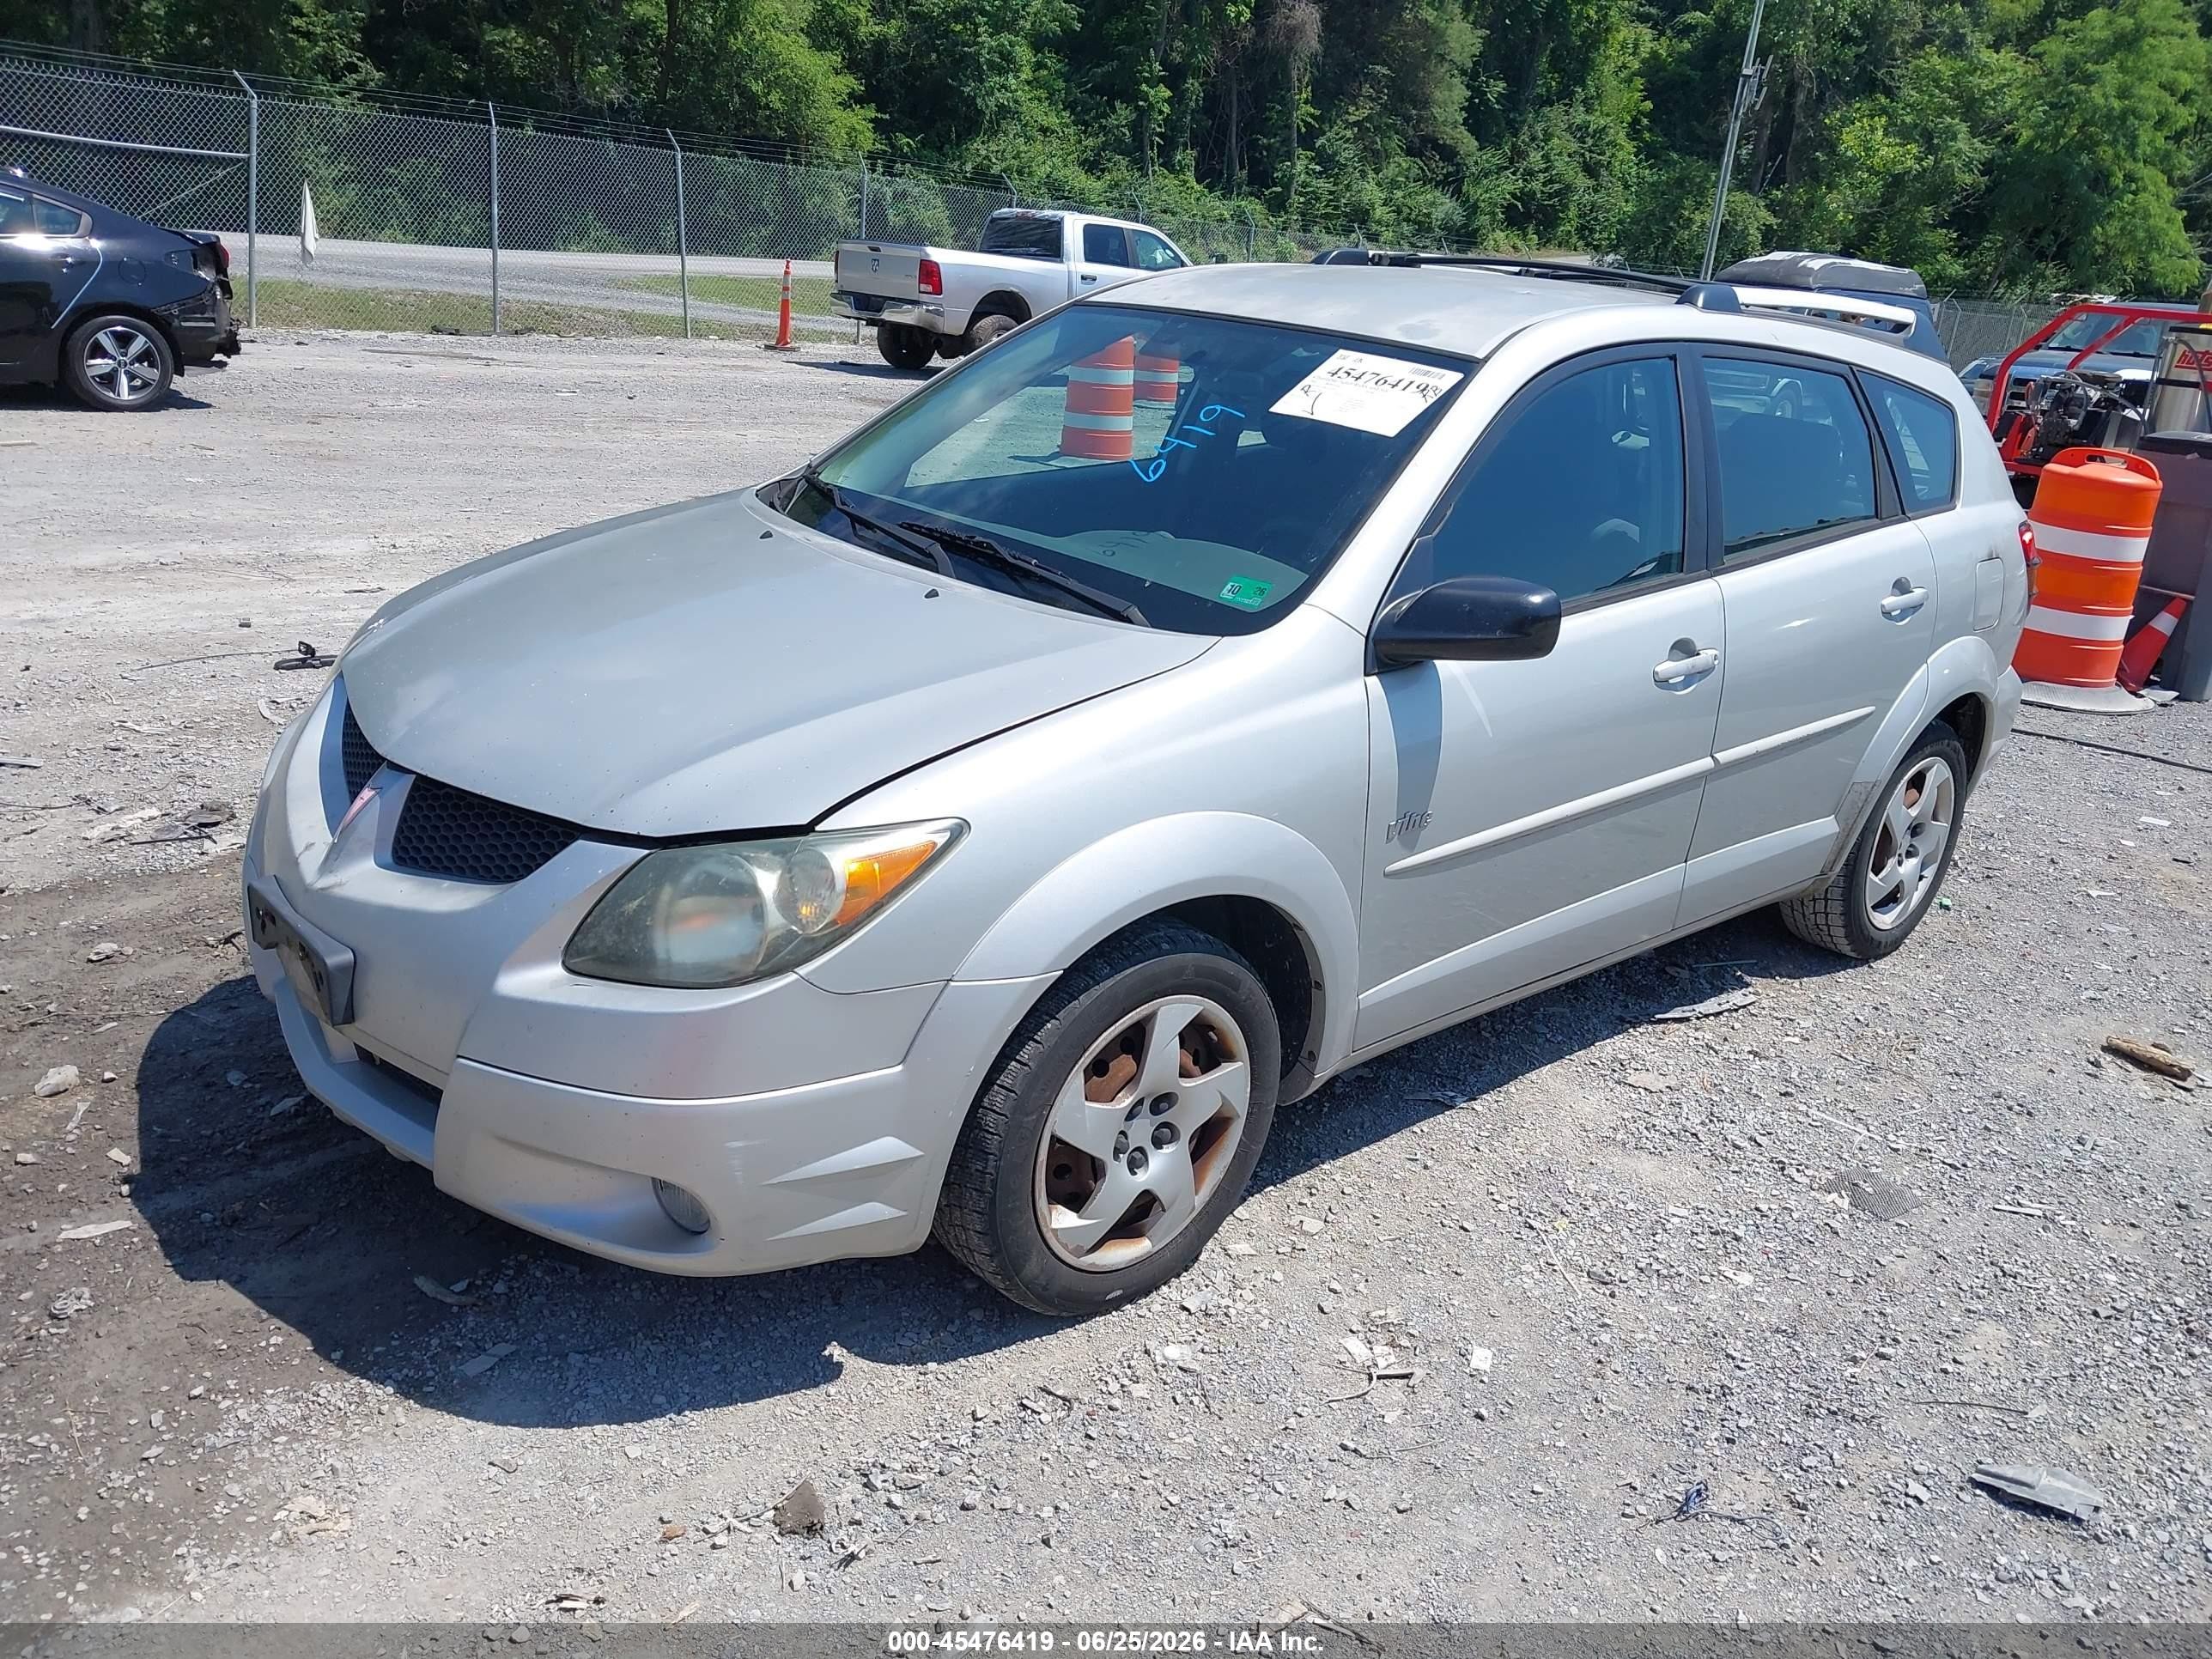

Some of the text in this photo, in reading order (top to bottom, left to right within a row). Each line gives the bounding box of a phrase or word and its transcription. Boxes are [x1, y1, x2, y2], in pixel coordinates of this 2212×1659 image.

[1327, 366, 1430, 394] 45476419
[1129, 404, 1246, 483] 6419
[1227, 584, 1243, 595] 10
